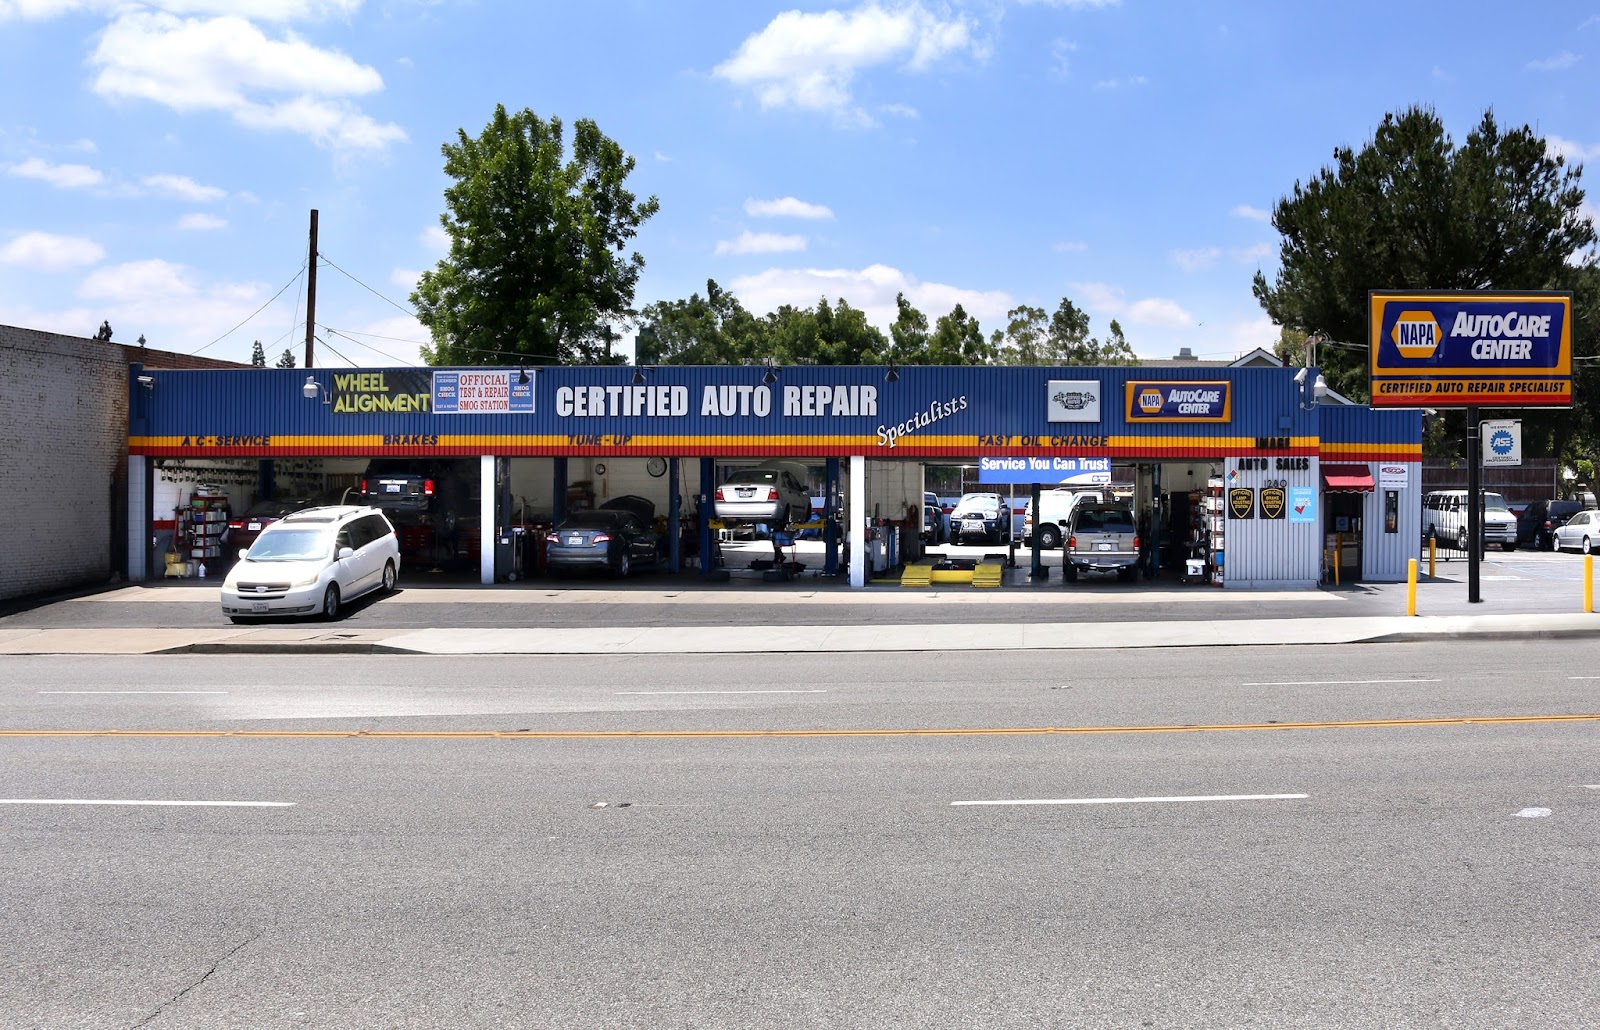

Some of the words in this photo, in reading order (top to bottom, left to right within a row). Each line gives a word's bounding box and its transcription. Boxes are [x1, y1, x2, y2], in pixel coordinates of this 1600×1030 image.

[1450, 311, 1551, 338] AUTOCARE
[1400, 323, 1434, 345] NAPA
[1470, 339, 1532, 360] CENTER
[333, 373, 389, 392] WHEEL
[460, 374, 508, 386] OFFICIAL
[460, 387, 476, 398] TEST
[478, 387, 483, 397] &
[484, 387, 509, 398] REPAIR
[1379, 382, 1432, 394] CERTIFIED
[1436, 382, 1464, 393] AUTO
[1467, 382, 1505, 393] REPAIR
[1508, 382, 1565, 393] SPECIALIST
[333, 393, 430, 412] ALIGNMENT
[460, 400, 479, 410] SMOG
[480, 400, 508, 410] STATION
[556, 386, 689, 417] CERTIFIED
[700, 385, 771, 417] AUTO
[783, 385, 878, 416] REPAIR
[1142, 395, 1160, 407] NAPA
[1178, 403, 1210, 414] CENTER
[877, 395, 968, 449] Specialists
[383, 434, 438, 446] BRAKES
[978, 435, 1012, 447] FAST
[1020, 435, 1042, 447] OIL
[1050, 435, 1109, 447] CHANGE
[1256, 437, 1290, 450] IMAGE
[1493, 437, 1511, 447] ASE
[981, 457, 1026, 471] Service
[1028, 457, 1050, 471] You
[1053, 457, 1076, 471] Can
[1078, 457, 1109, 471] Trust
[1238, 458, 1268, 471] AUTO
[1276, 457, 1309, 471] SALES
[1264, 479, 1288, 489] 1280
